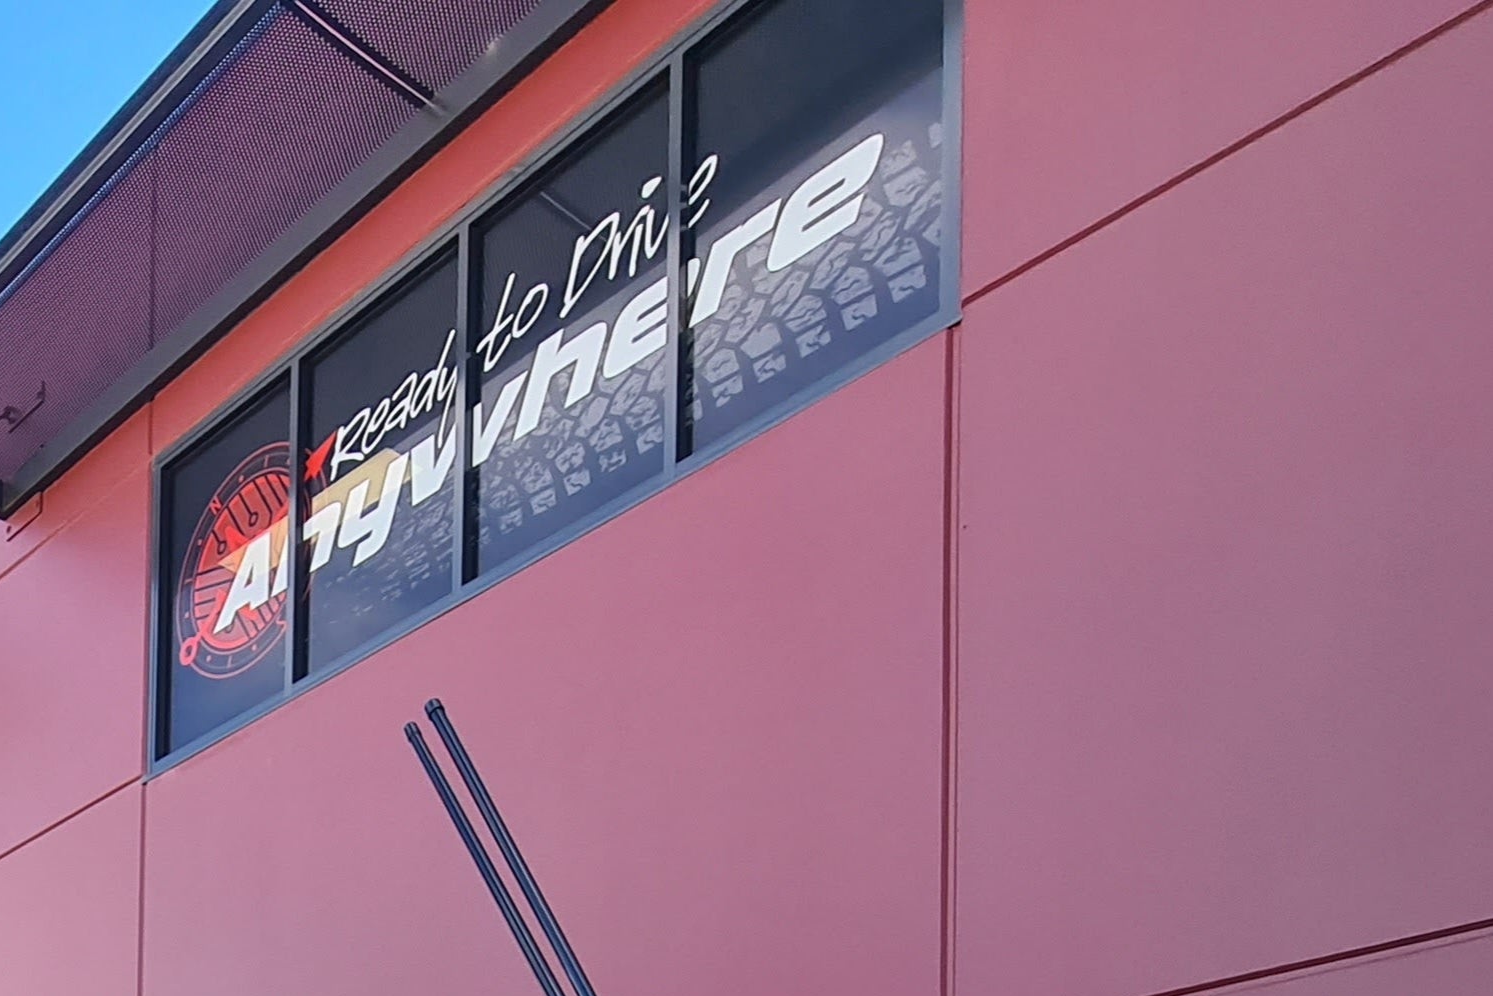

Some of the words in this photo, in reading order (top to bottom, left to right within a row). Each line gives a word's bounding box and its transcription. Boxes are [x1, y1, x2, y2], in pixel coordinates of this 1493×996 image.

[213, 133, 884, 635] Anywhere
[331, 329, 457, 478] Ready
[477, 273, 549, 373] to
[559, 154, 718, 319] Drive
